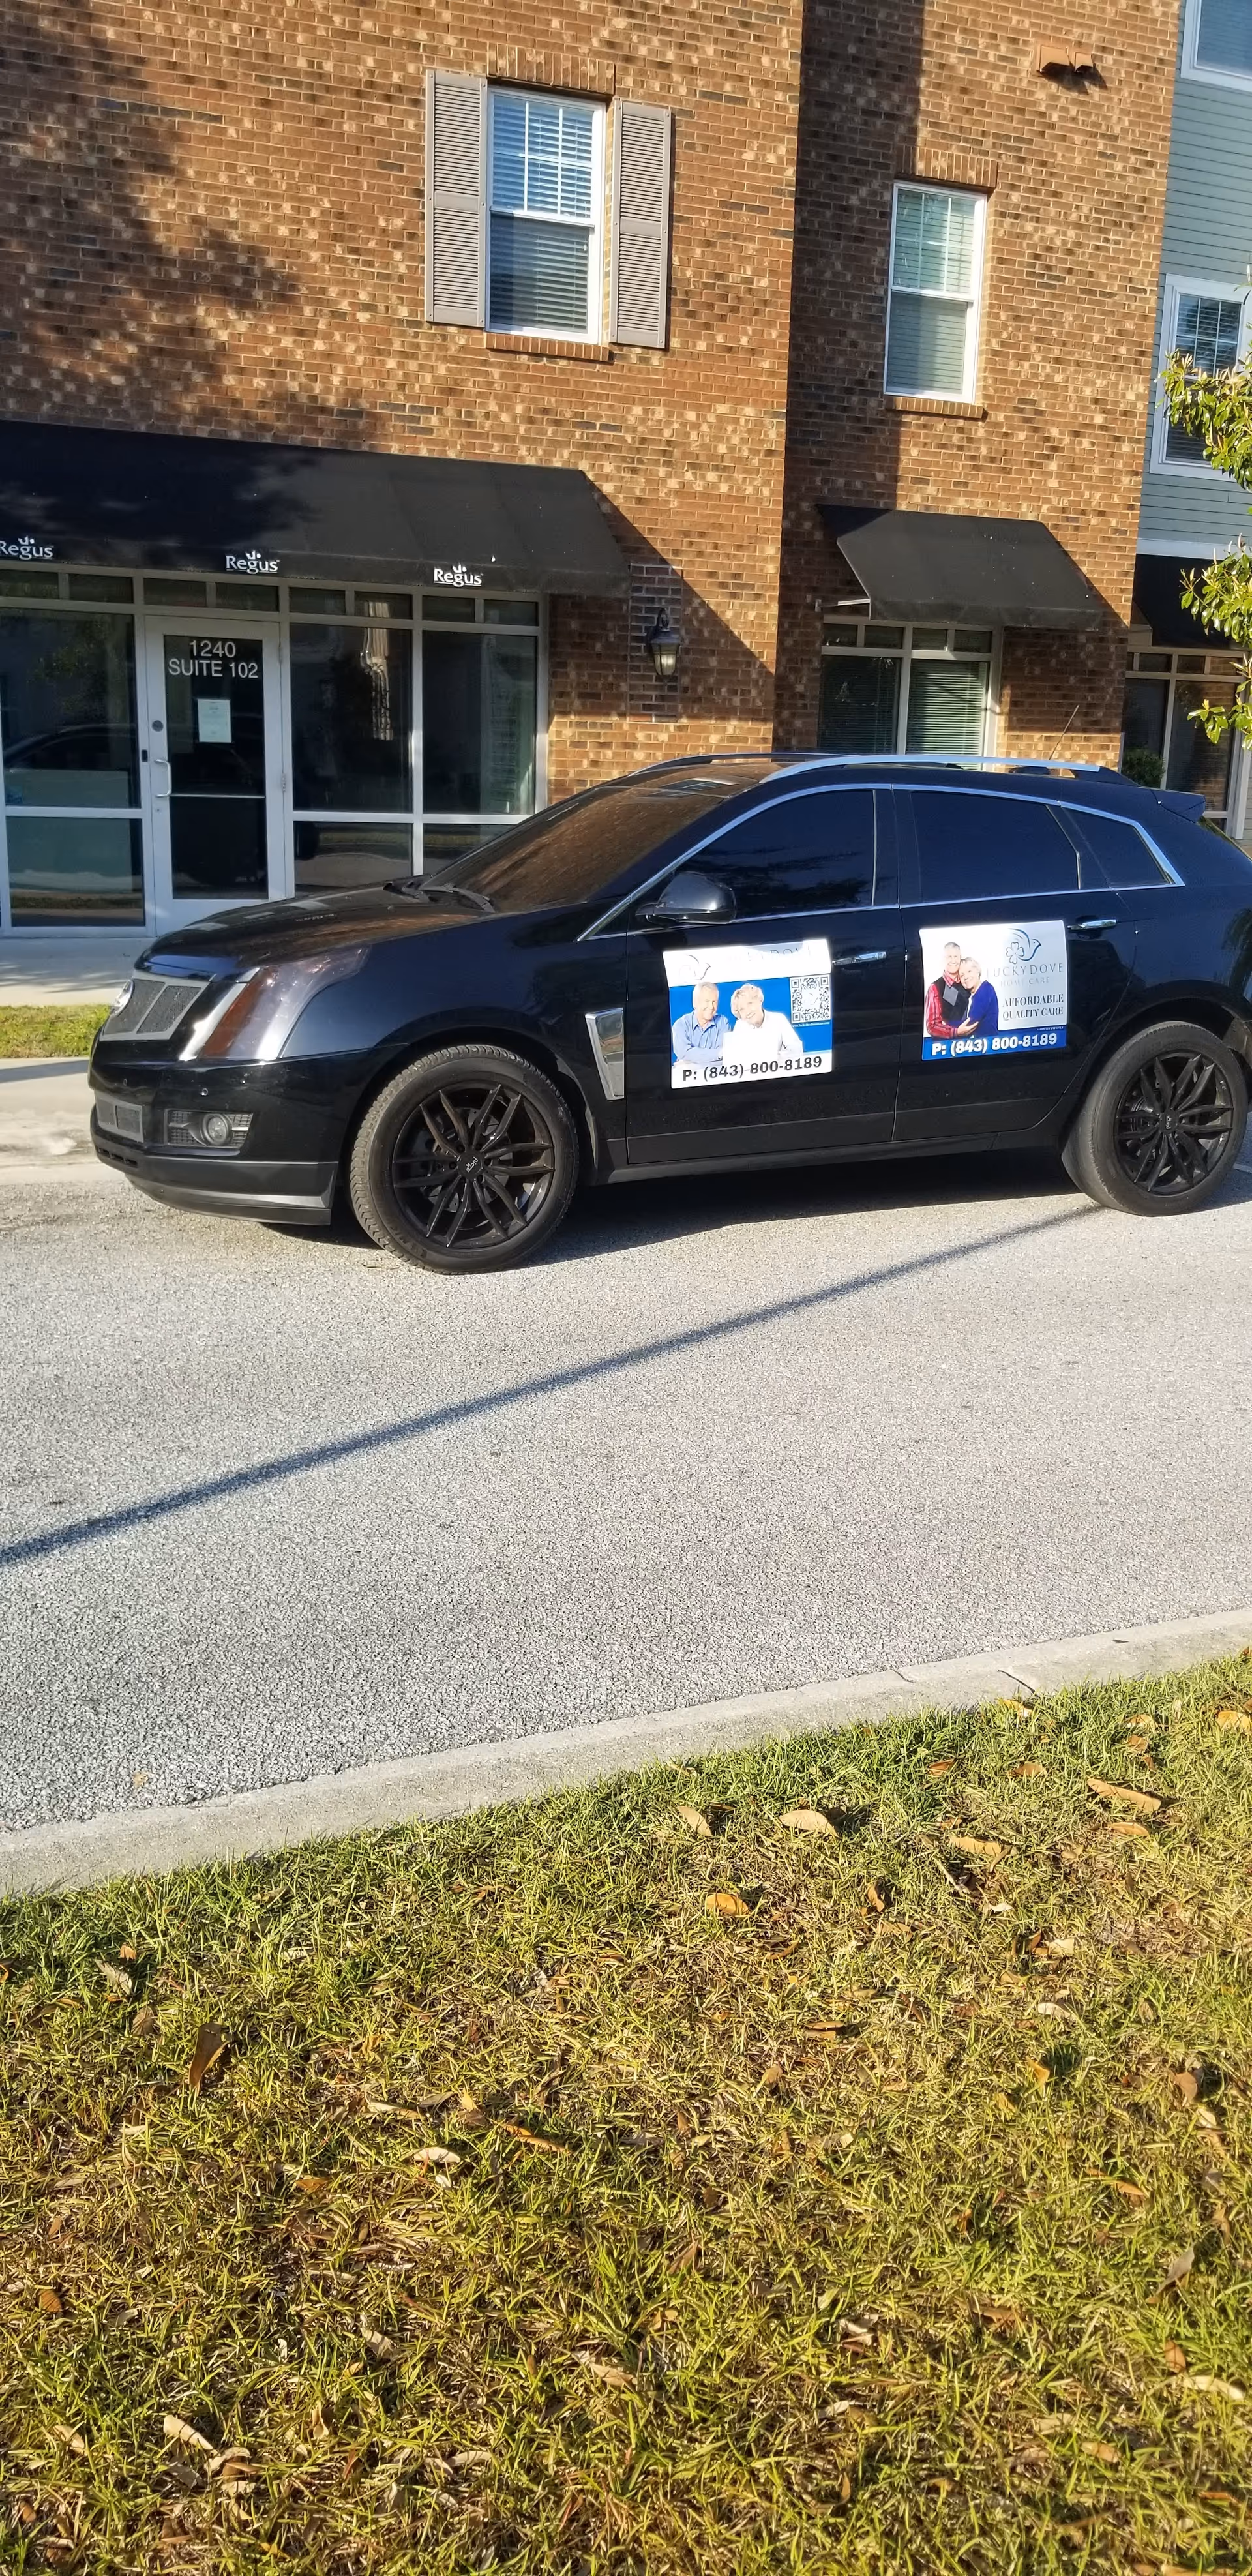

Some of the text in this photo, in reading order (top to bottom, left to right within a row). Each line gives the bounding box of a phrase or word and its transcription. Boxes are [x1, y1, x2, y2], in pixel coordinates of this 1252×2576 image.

[0, 540, 53, 560] Regus
[226, 555, 278, 575] Regus
[434, 568, 483, 587] Regus
[189, 640, 236, 658] 1240
[168, 658, 258, 678] SUITE 102
[1002, 993, 1064, 1007] AFFORDABLE
[1002, 1007, 1064, 1021] QUALITY CARE
[931, 1032, 1058, 1056] P: (843) 800-8189
[682, 1056, 822, 1082] P: (843) 800-8189
